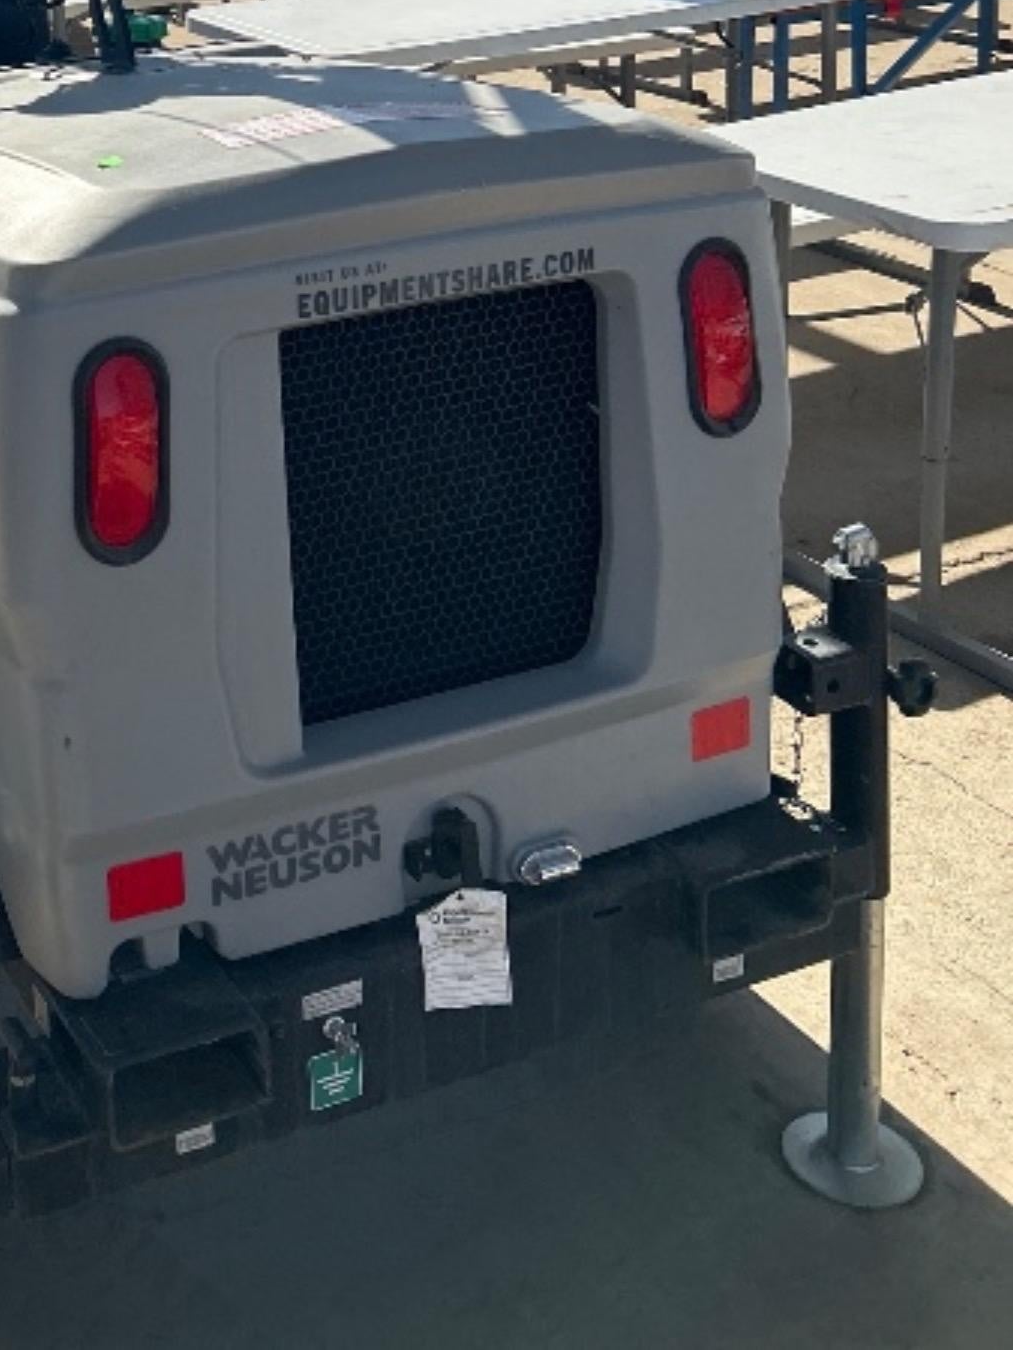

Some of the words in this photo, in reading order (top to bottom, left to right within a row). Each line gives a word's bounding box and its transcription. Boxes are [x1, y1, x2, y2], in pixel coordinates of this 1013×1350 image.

[297, 248, 594, 319] EQUIPMENTSHARE.COM
[206, 804, 380, 874] WACKER
[211, 833, 382, 907] NEUSON
